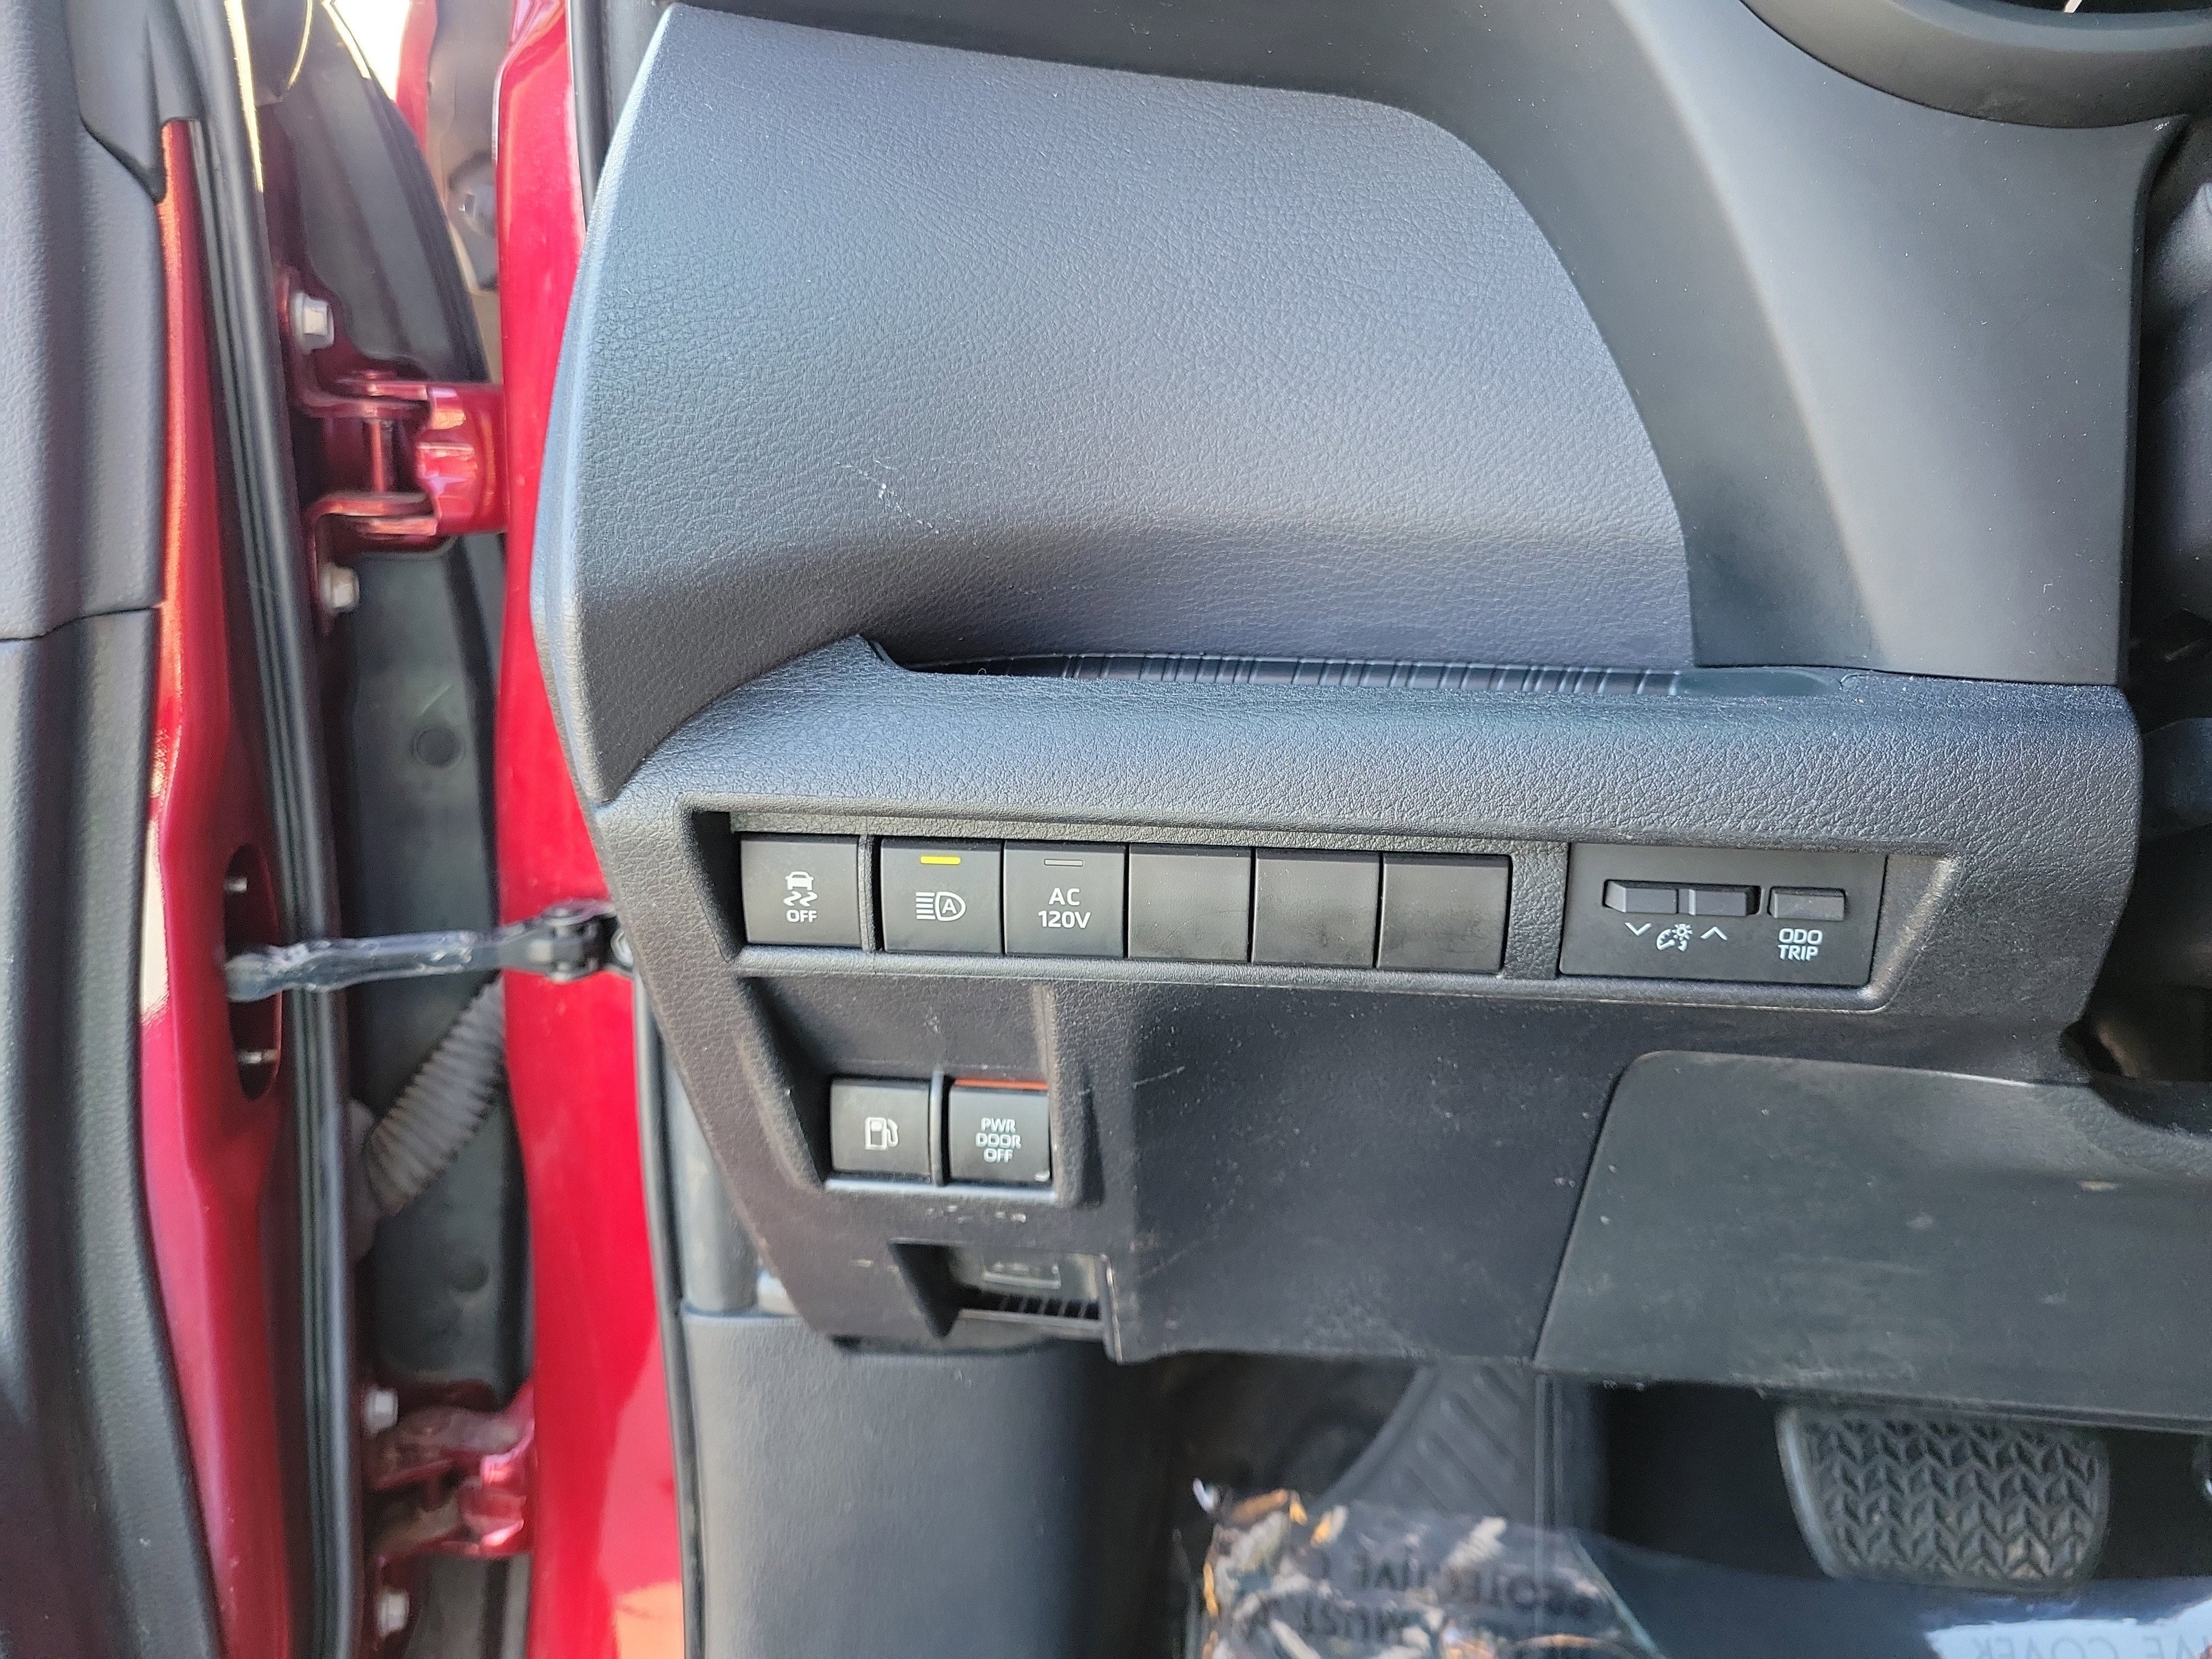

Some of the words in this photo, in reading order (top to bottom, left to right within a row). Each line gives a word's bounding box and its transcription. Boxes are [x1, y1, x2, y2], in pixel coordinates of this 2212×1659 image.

[1048, 887, 1080, 906] AC
[941, 899, 956, 915] A
[786, 909, 817, 923] OFF
[1038, 910, 1092, 929] 120V
[1778, 928, 1823, 945] ODO
[1778, 944, 1819, 962] TRIP
[980, 1117, 1016, 1133] PWR
[975, 1132, 1022, 1149] DOOR
[983, 1149, 1013, 1163] OFF
